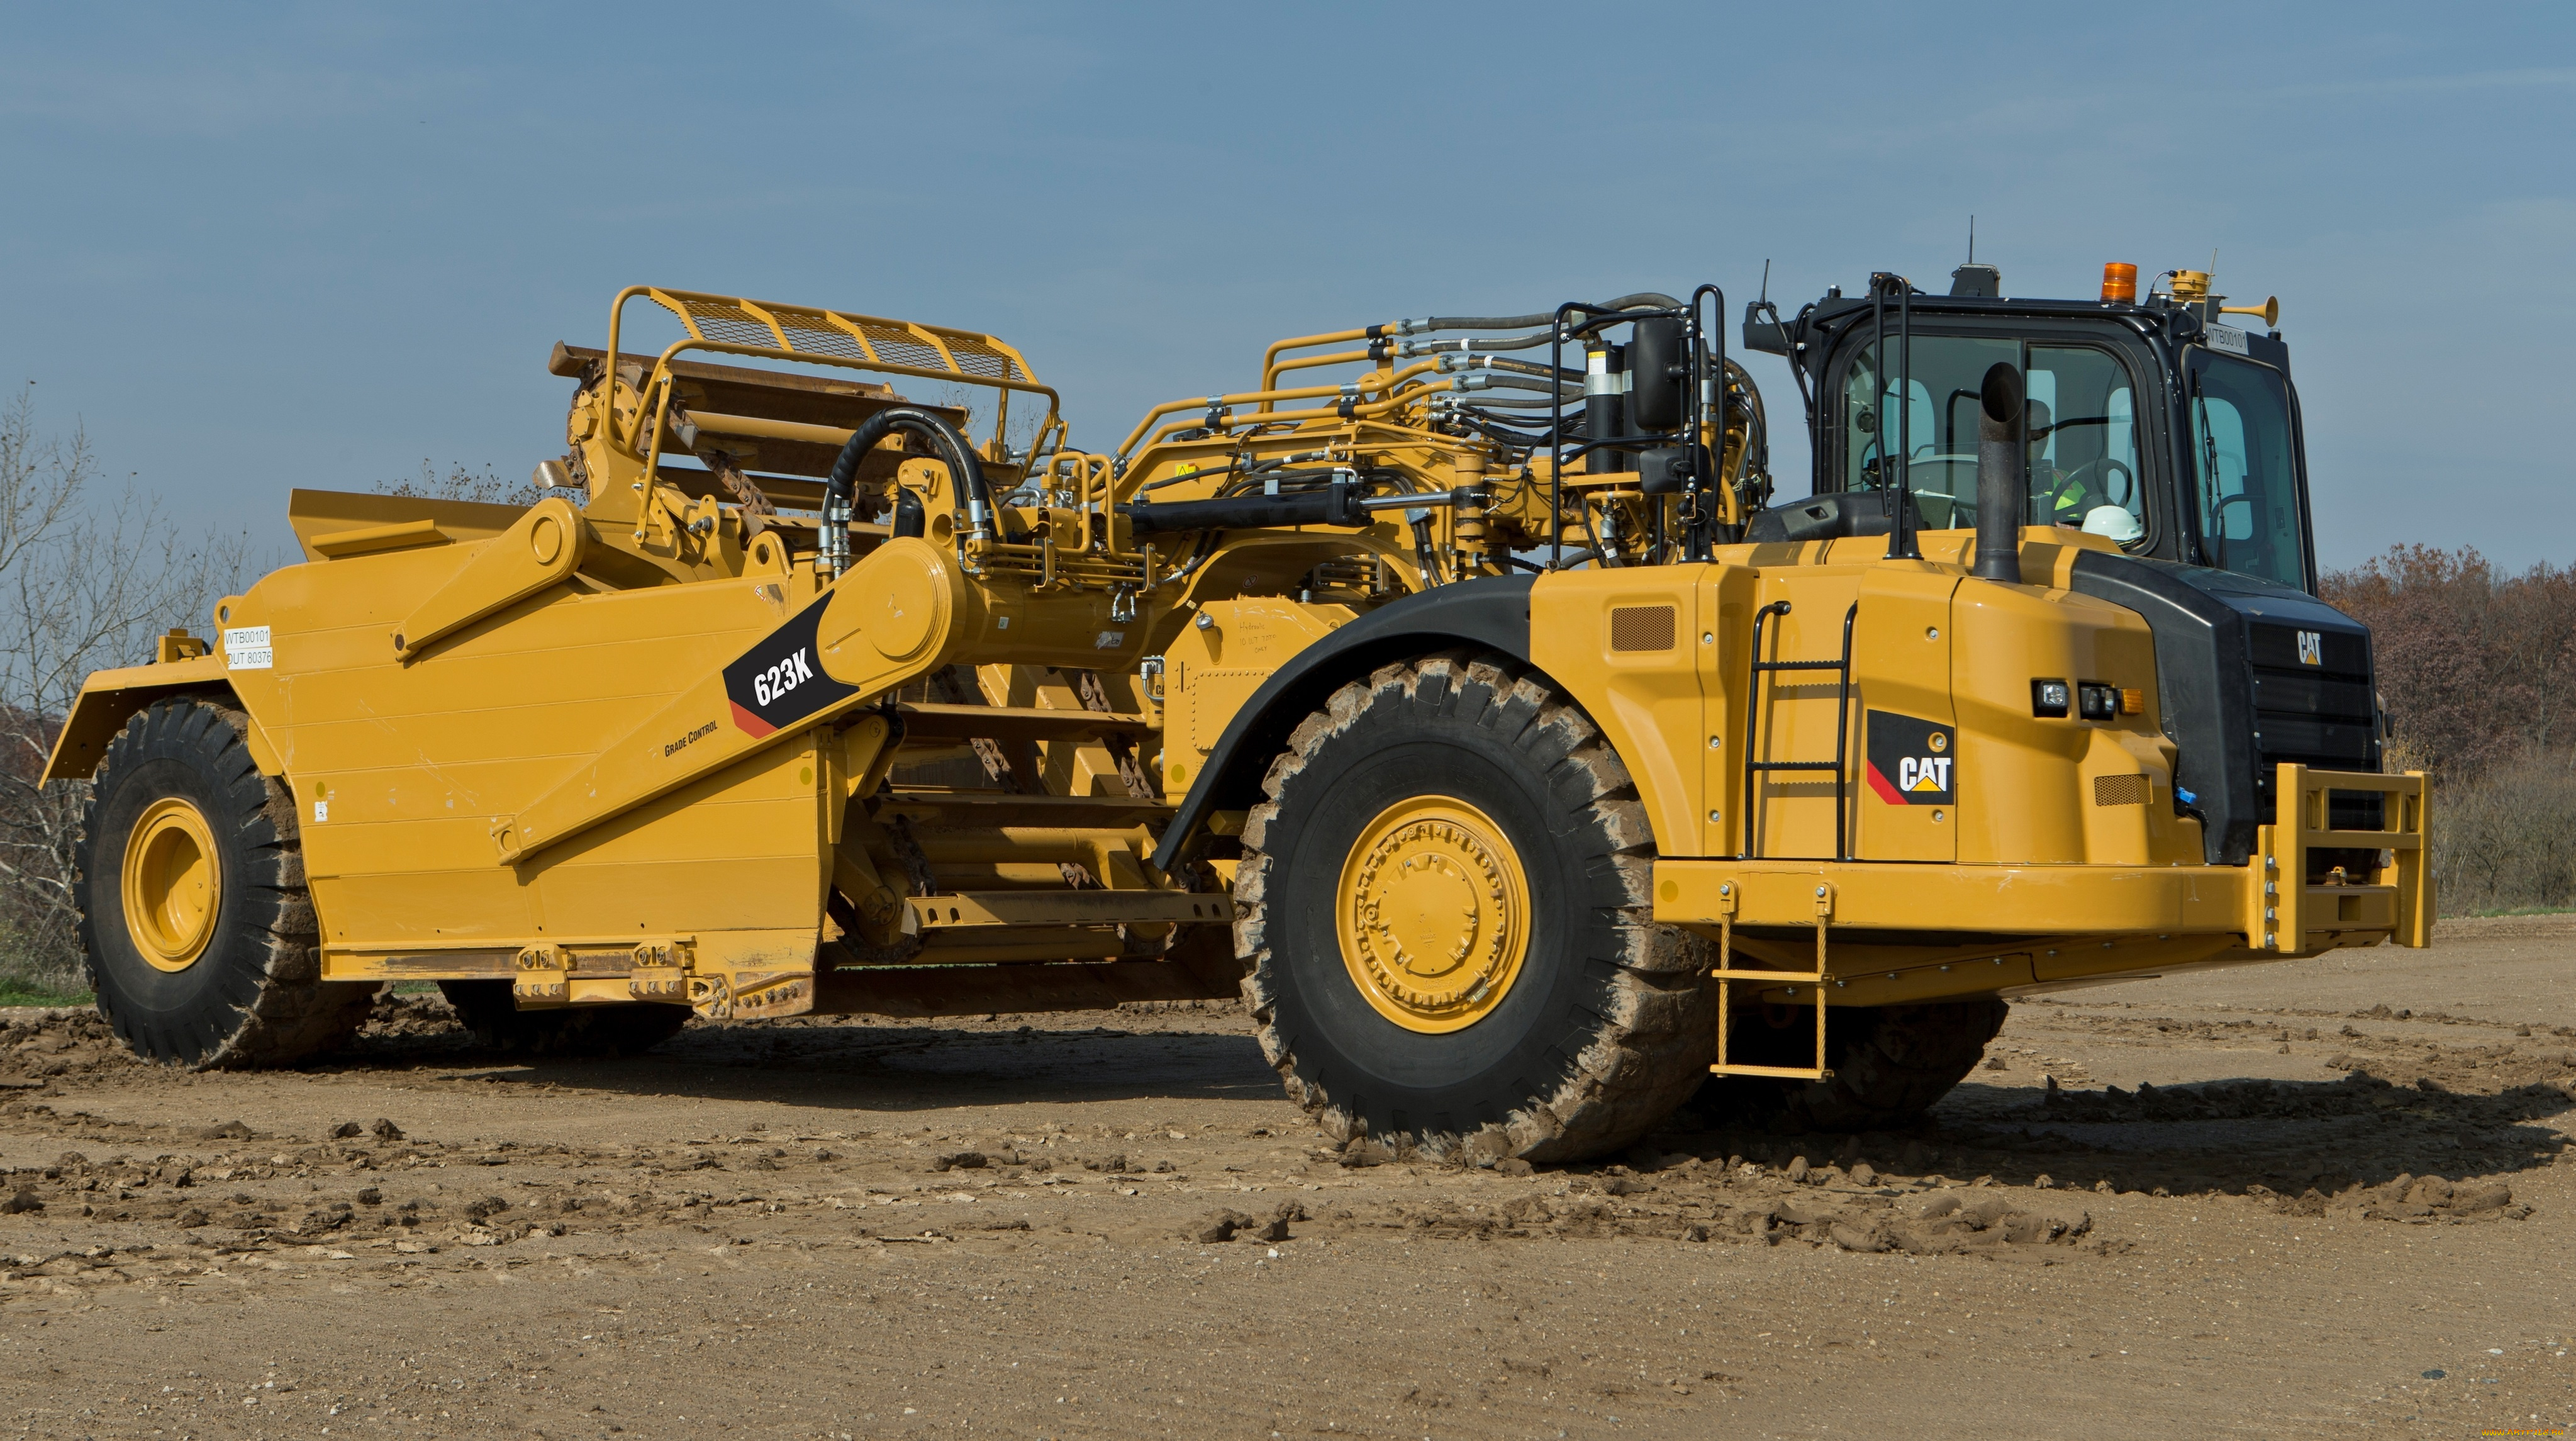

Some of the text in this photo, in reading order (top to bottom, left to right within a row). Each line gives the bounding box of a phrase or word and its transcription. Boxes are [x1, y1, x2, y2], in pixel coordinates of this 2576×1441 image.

[2207, 328, 2246, 349] WTB00101
[225, 630, 269, 645] WTB00101
[2297, 631, 2321, 666] CAT
[247, 651, 272, 664] 80376
[754, 647, 814, 707] 623K
[664, 720, 718, 758] GRADE CONTROL
[1900, 756, 1951, 792] CAT
